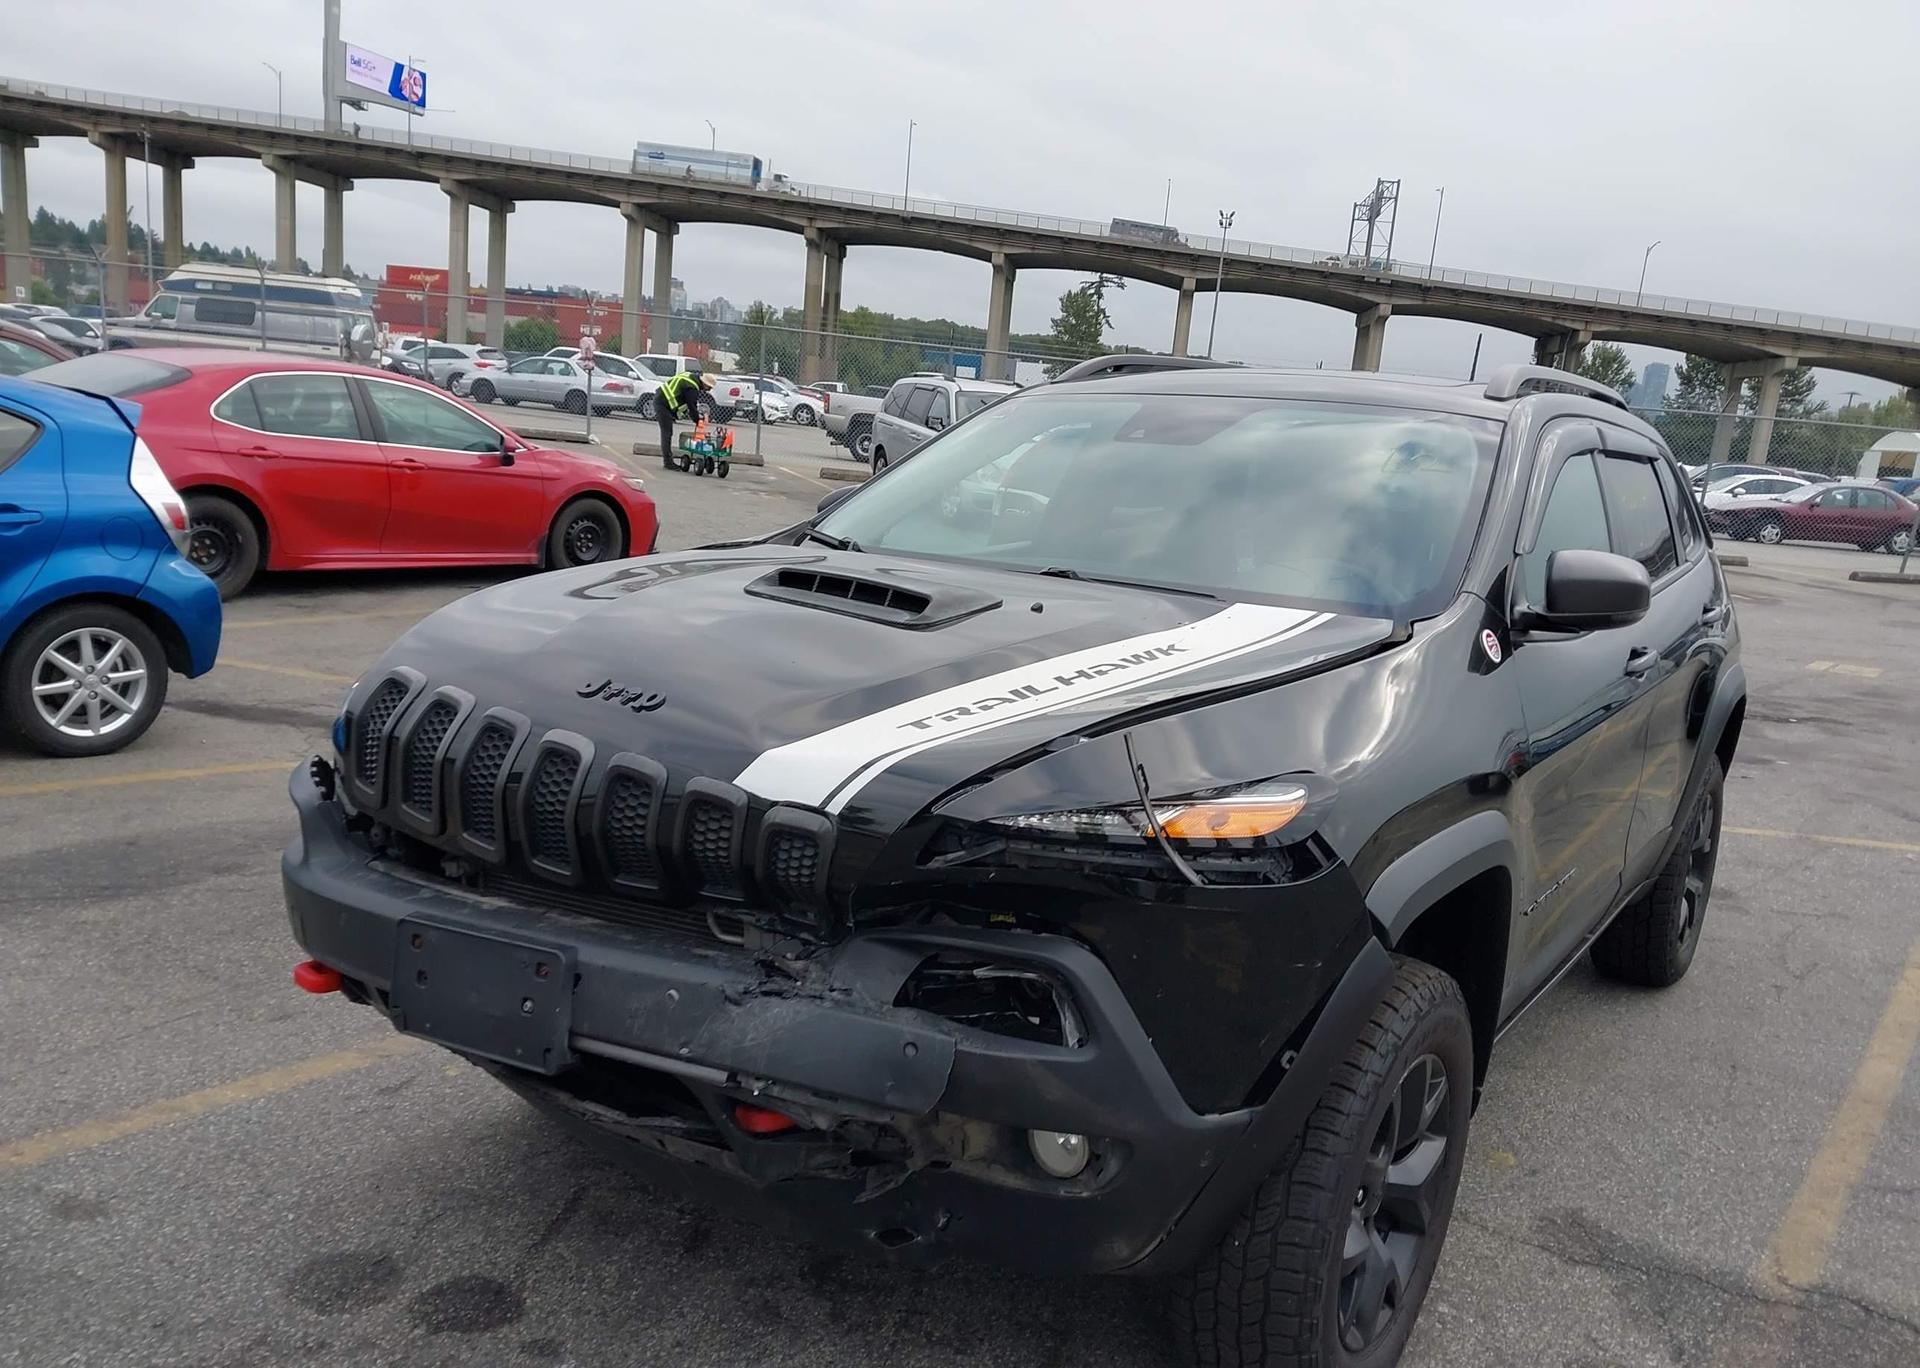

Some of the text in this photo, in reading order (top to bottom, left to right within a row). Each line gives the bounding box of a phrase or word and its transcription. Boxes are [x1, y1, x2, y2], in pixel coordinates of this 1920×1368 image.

[350, 54, 362, 67] Bell
[576, 679, 667, 713] Jeep
[896, 643, 1190, 730] TRAILHAWK
